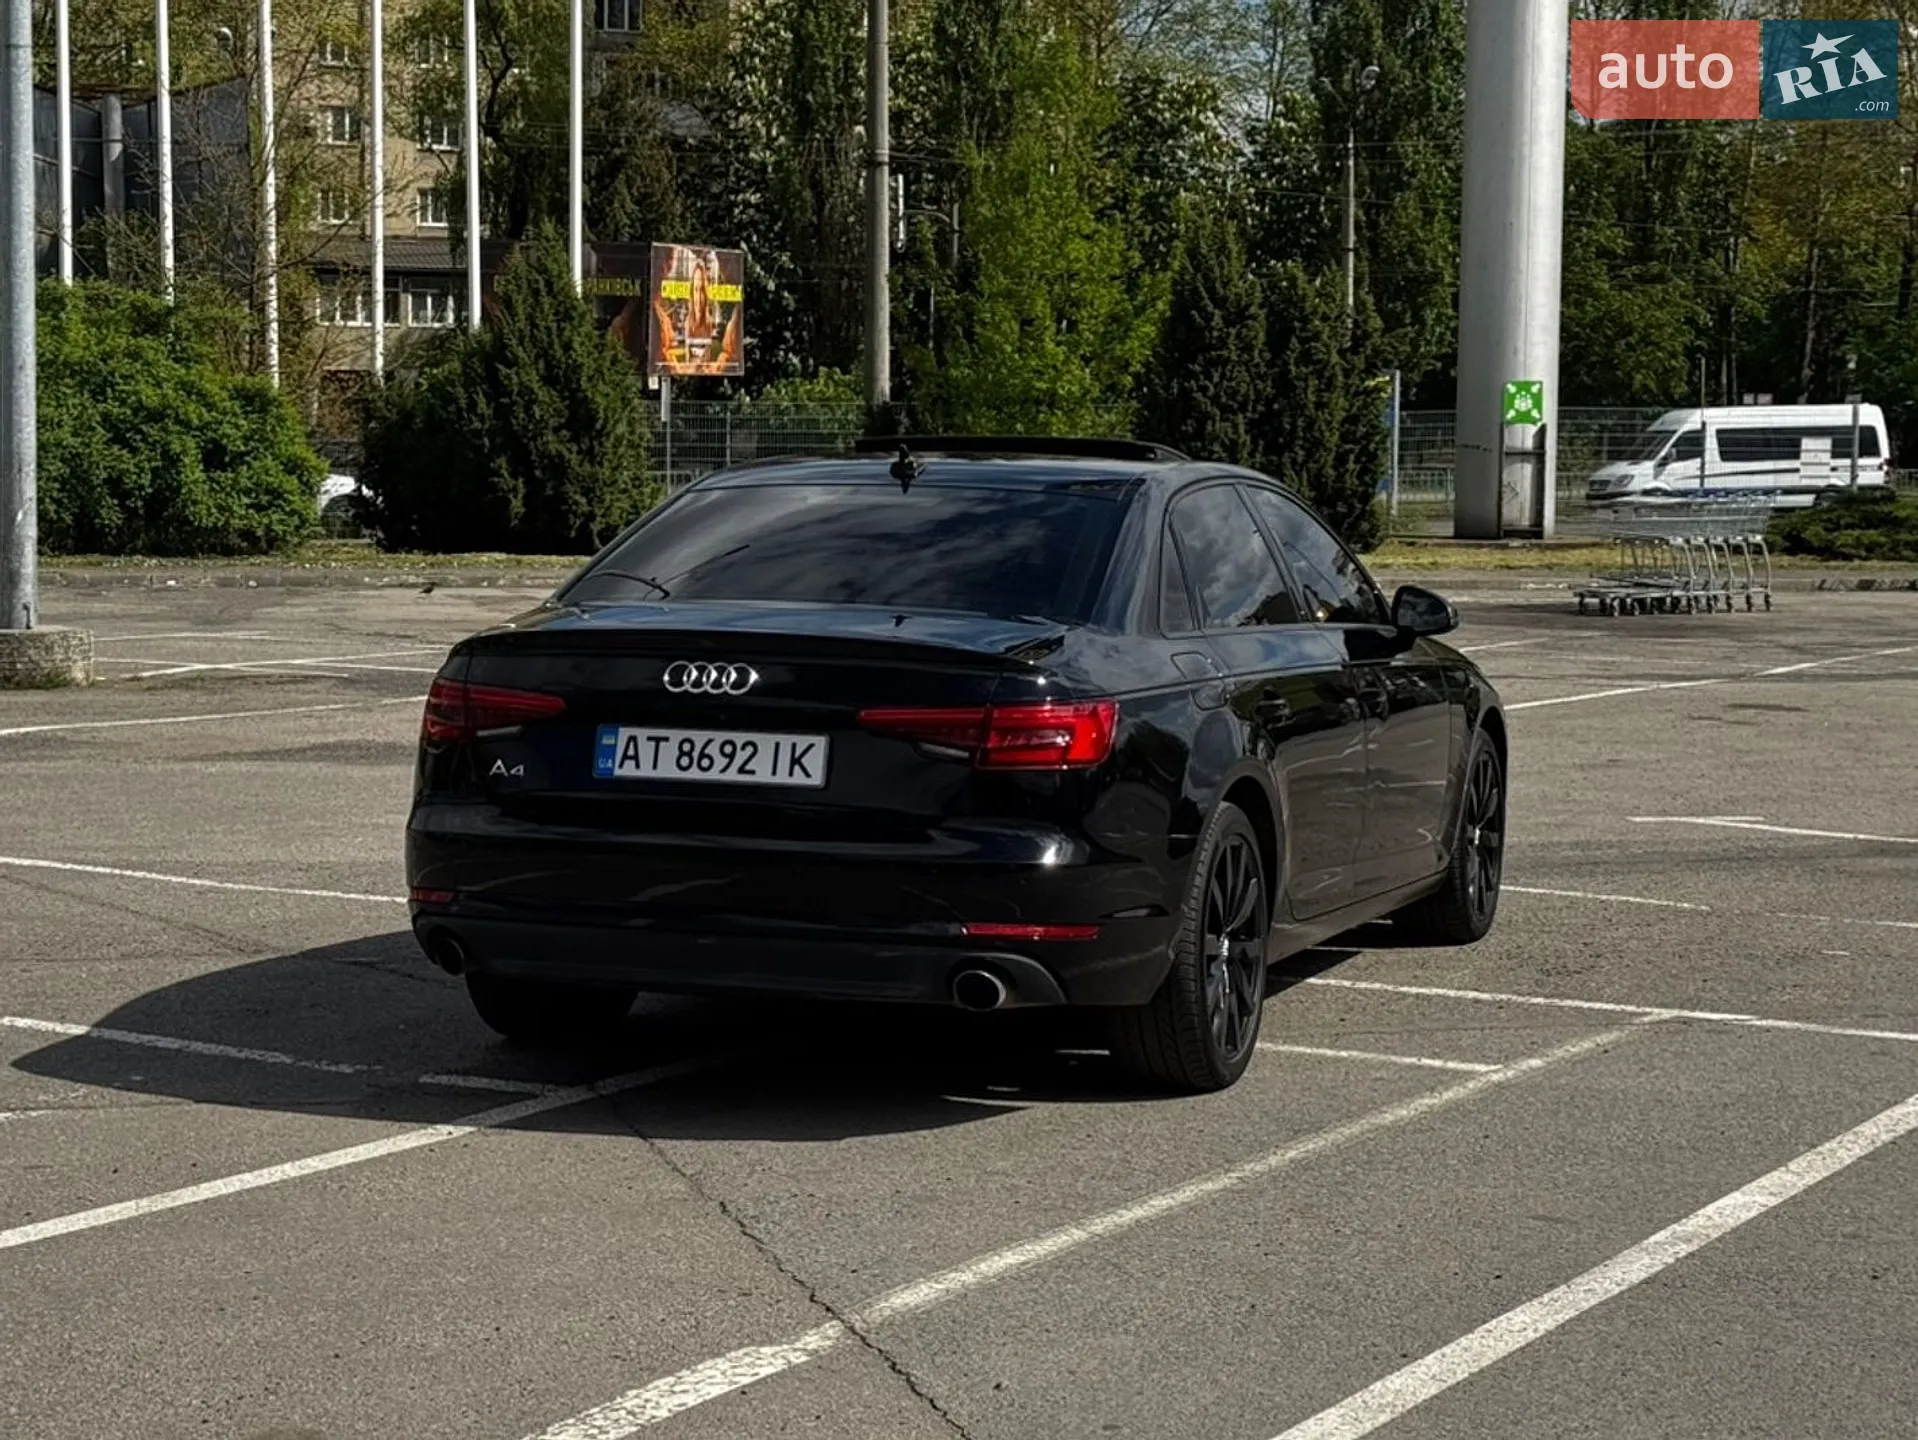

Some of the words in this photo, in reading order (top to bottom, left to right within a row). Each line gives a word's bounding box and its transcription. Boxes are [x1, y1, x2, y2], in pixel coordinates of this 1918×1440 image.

[598, 757, 614, 769] UA
[618, 735, 670, 772] AT
[675, 737, 758, 777] 8692
[770, 740, 816, 779] IK
[488, 758, 525, 777] A4
